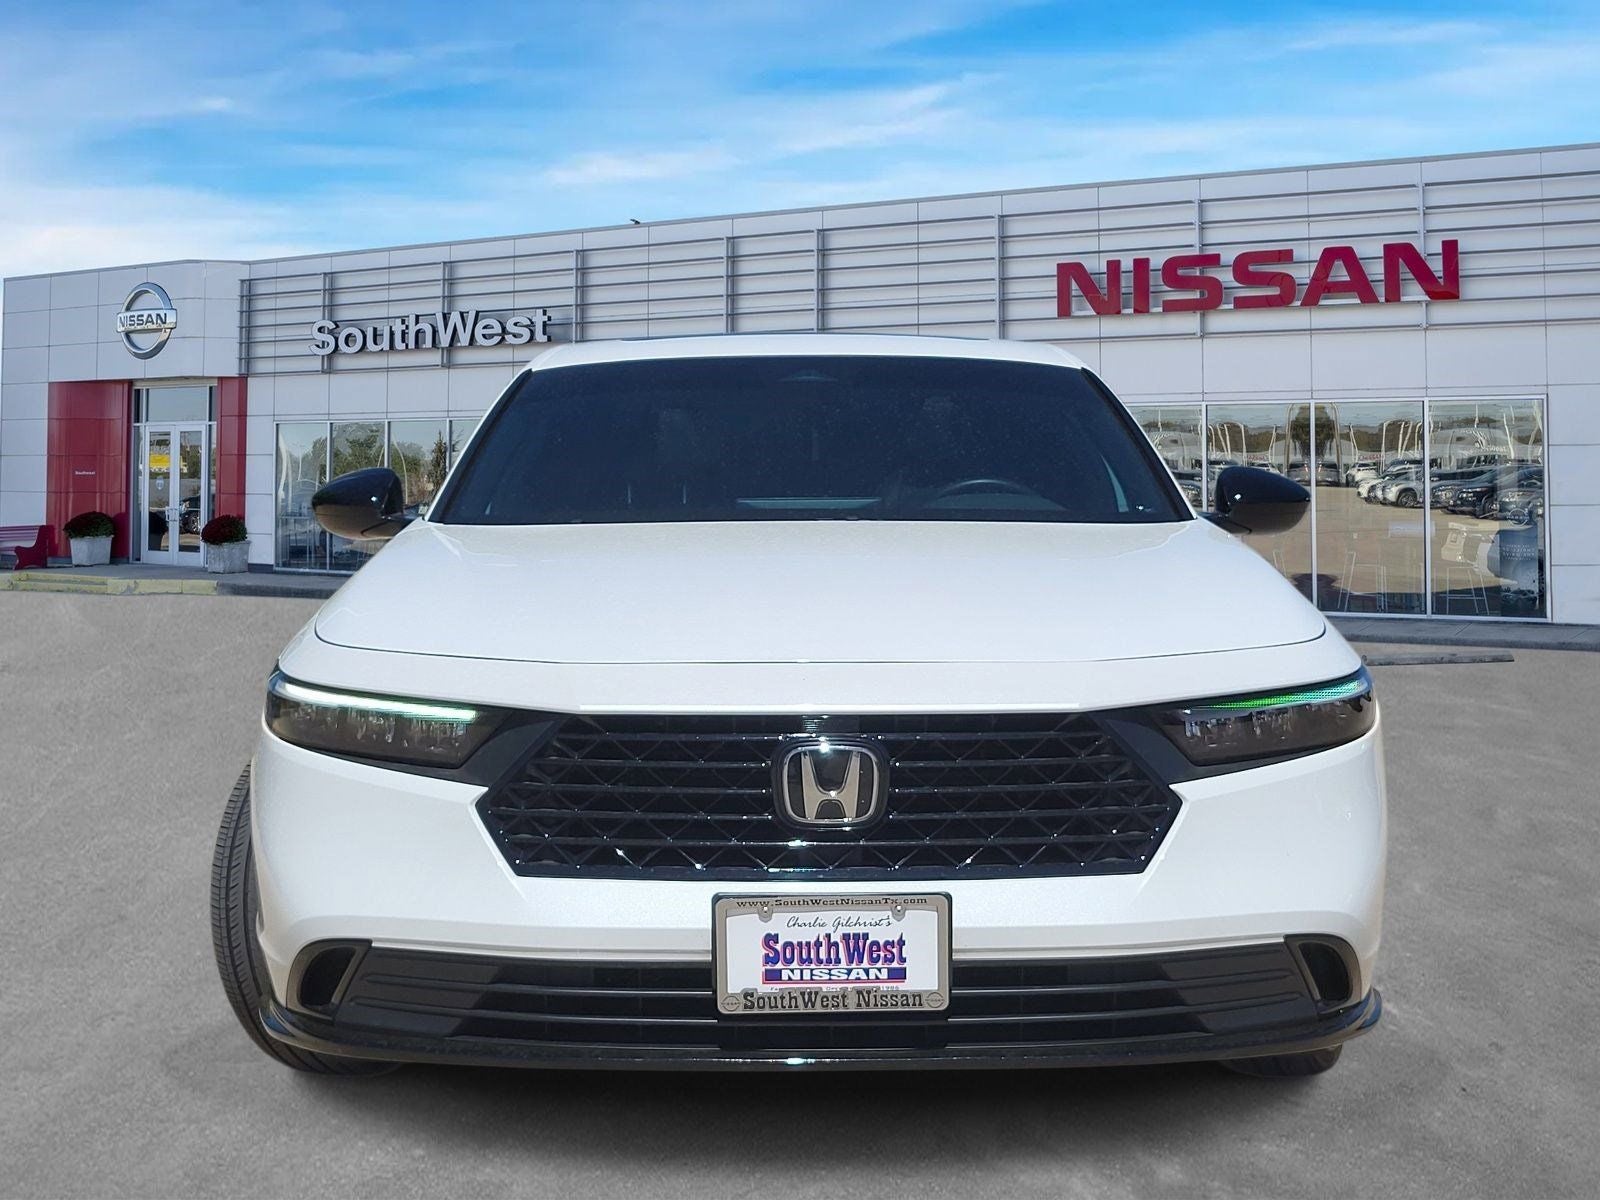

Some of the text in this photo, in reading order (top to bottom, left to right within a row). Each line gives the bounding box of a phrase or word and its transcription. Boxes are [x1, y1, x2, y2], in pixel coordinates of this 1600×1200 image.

[1056, 239, 1461, 318] NISSAN
[119, 312, 167, 328] NISSAN
[309, 308, 551, 356] SouthWest
[786, 914, 892, 934] Charlie Gilchrist's
[762, 932, 907, 967] SouthWest
[781, 968, 888, 981] NISSAN
[742, 988, 924, 1010] SouthWest Nissan
